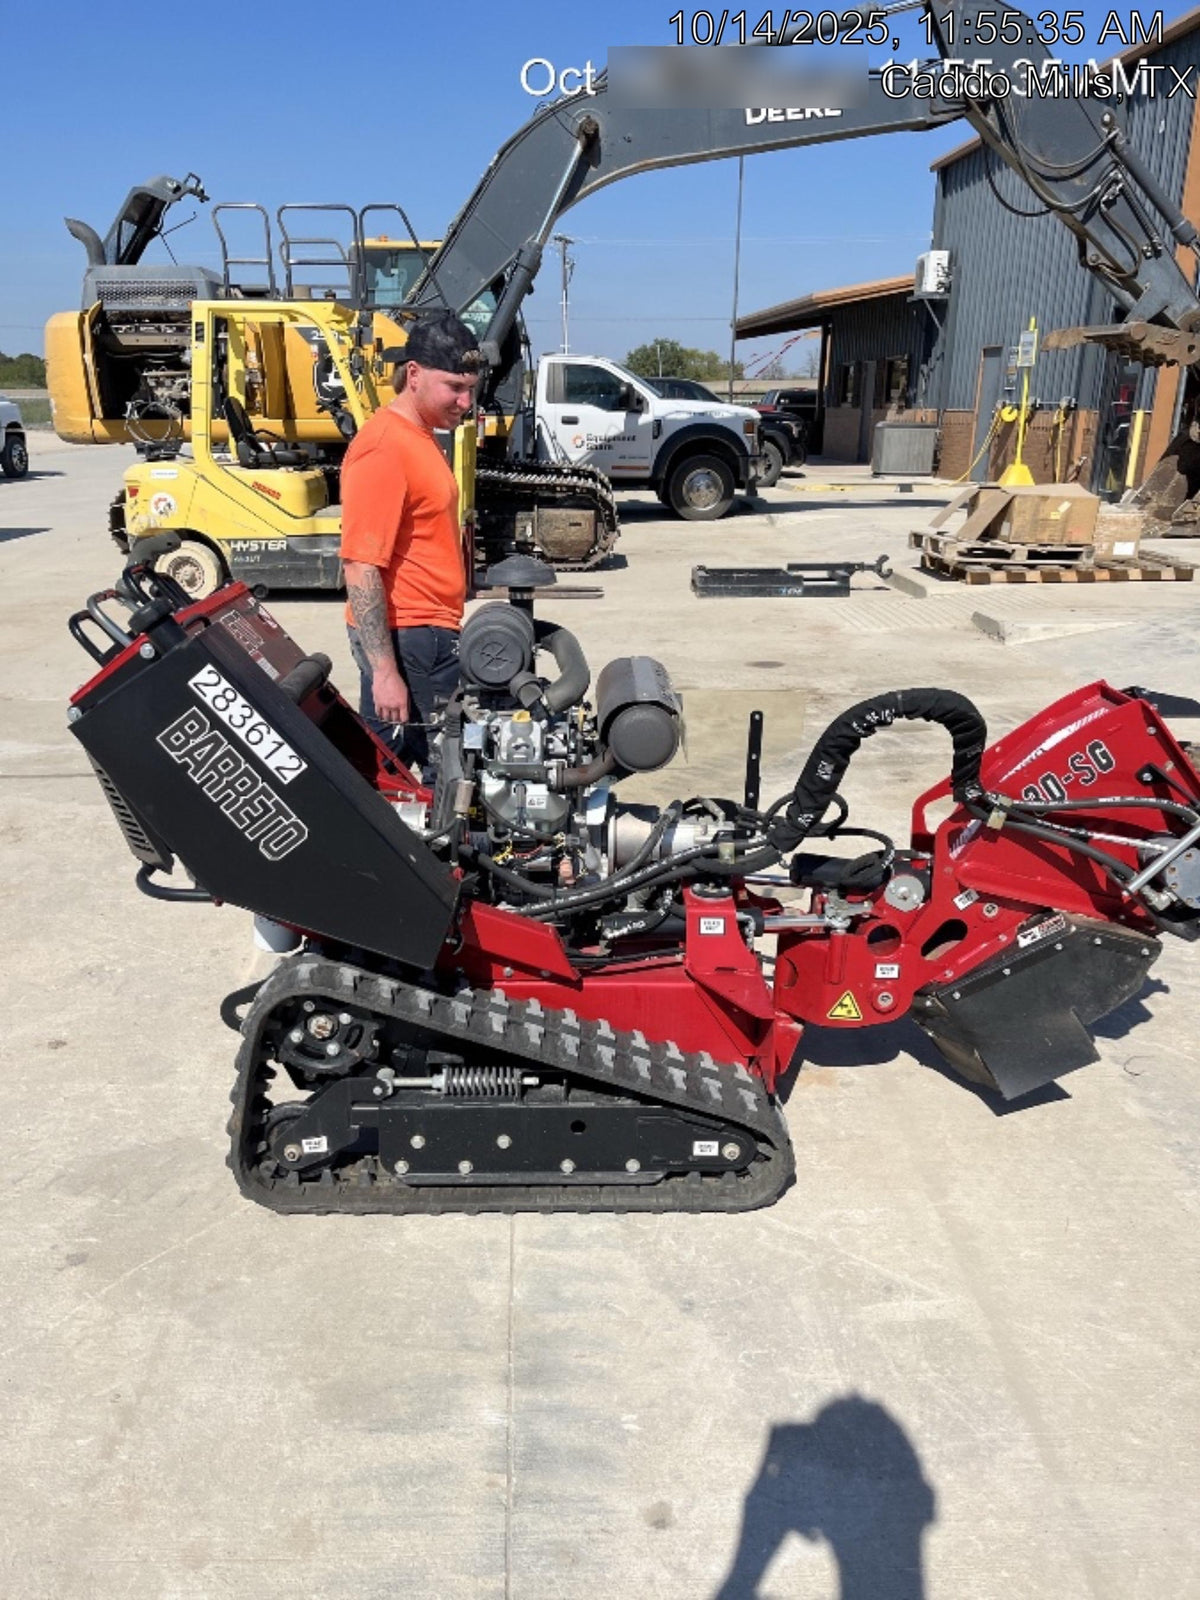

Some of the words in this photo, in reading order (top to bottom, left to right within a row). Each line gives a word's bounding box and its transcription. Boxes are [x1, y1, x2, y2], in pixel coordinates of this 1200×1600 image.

[230, 539, 287, 552] HYSTER
[193, 669, 303, 782] 283612
[155, 705, 309, 861] BARRETO
